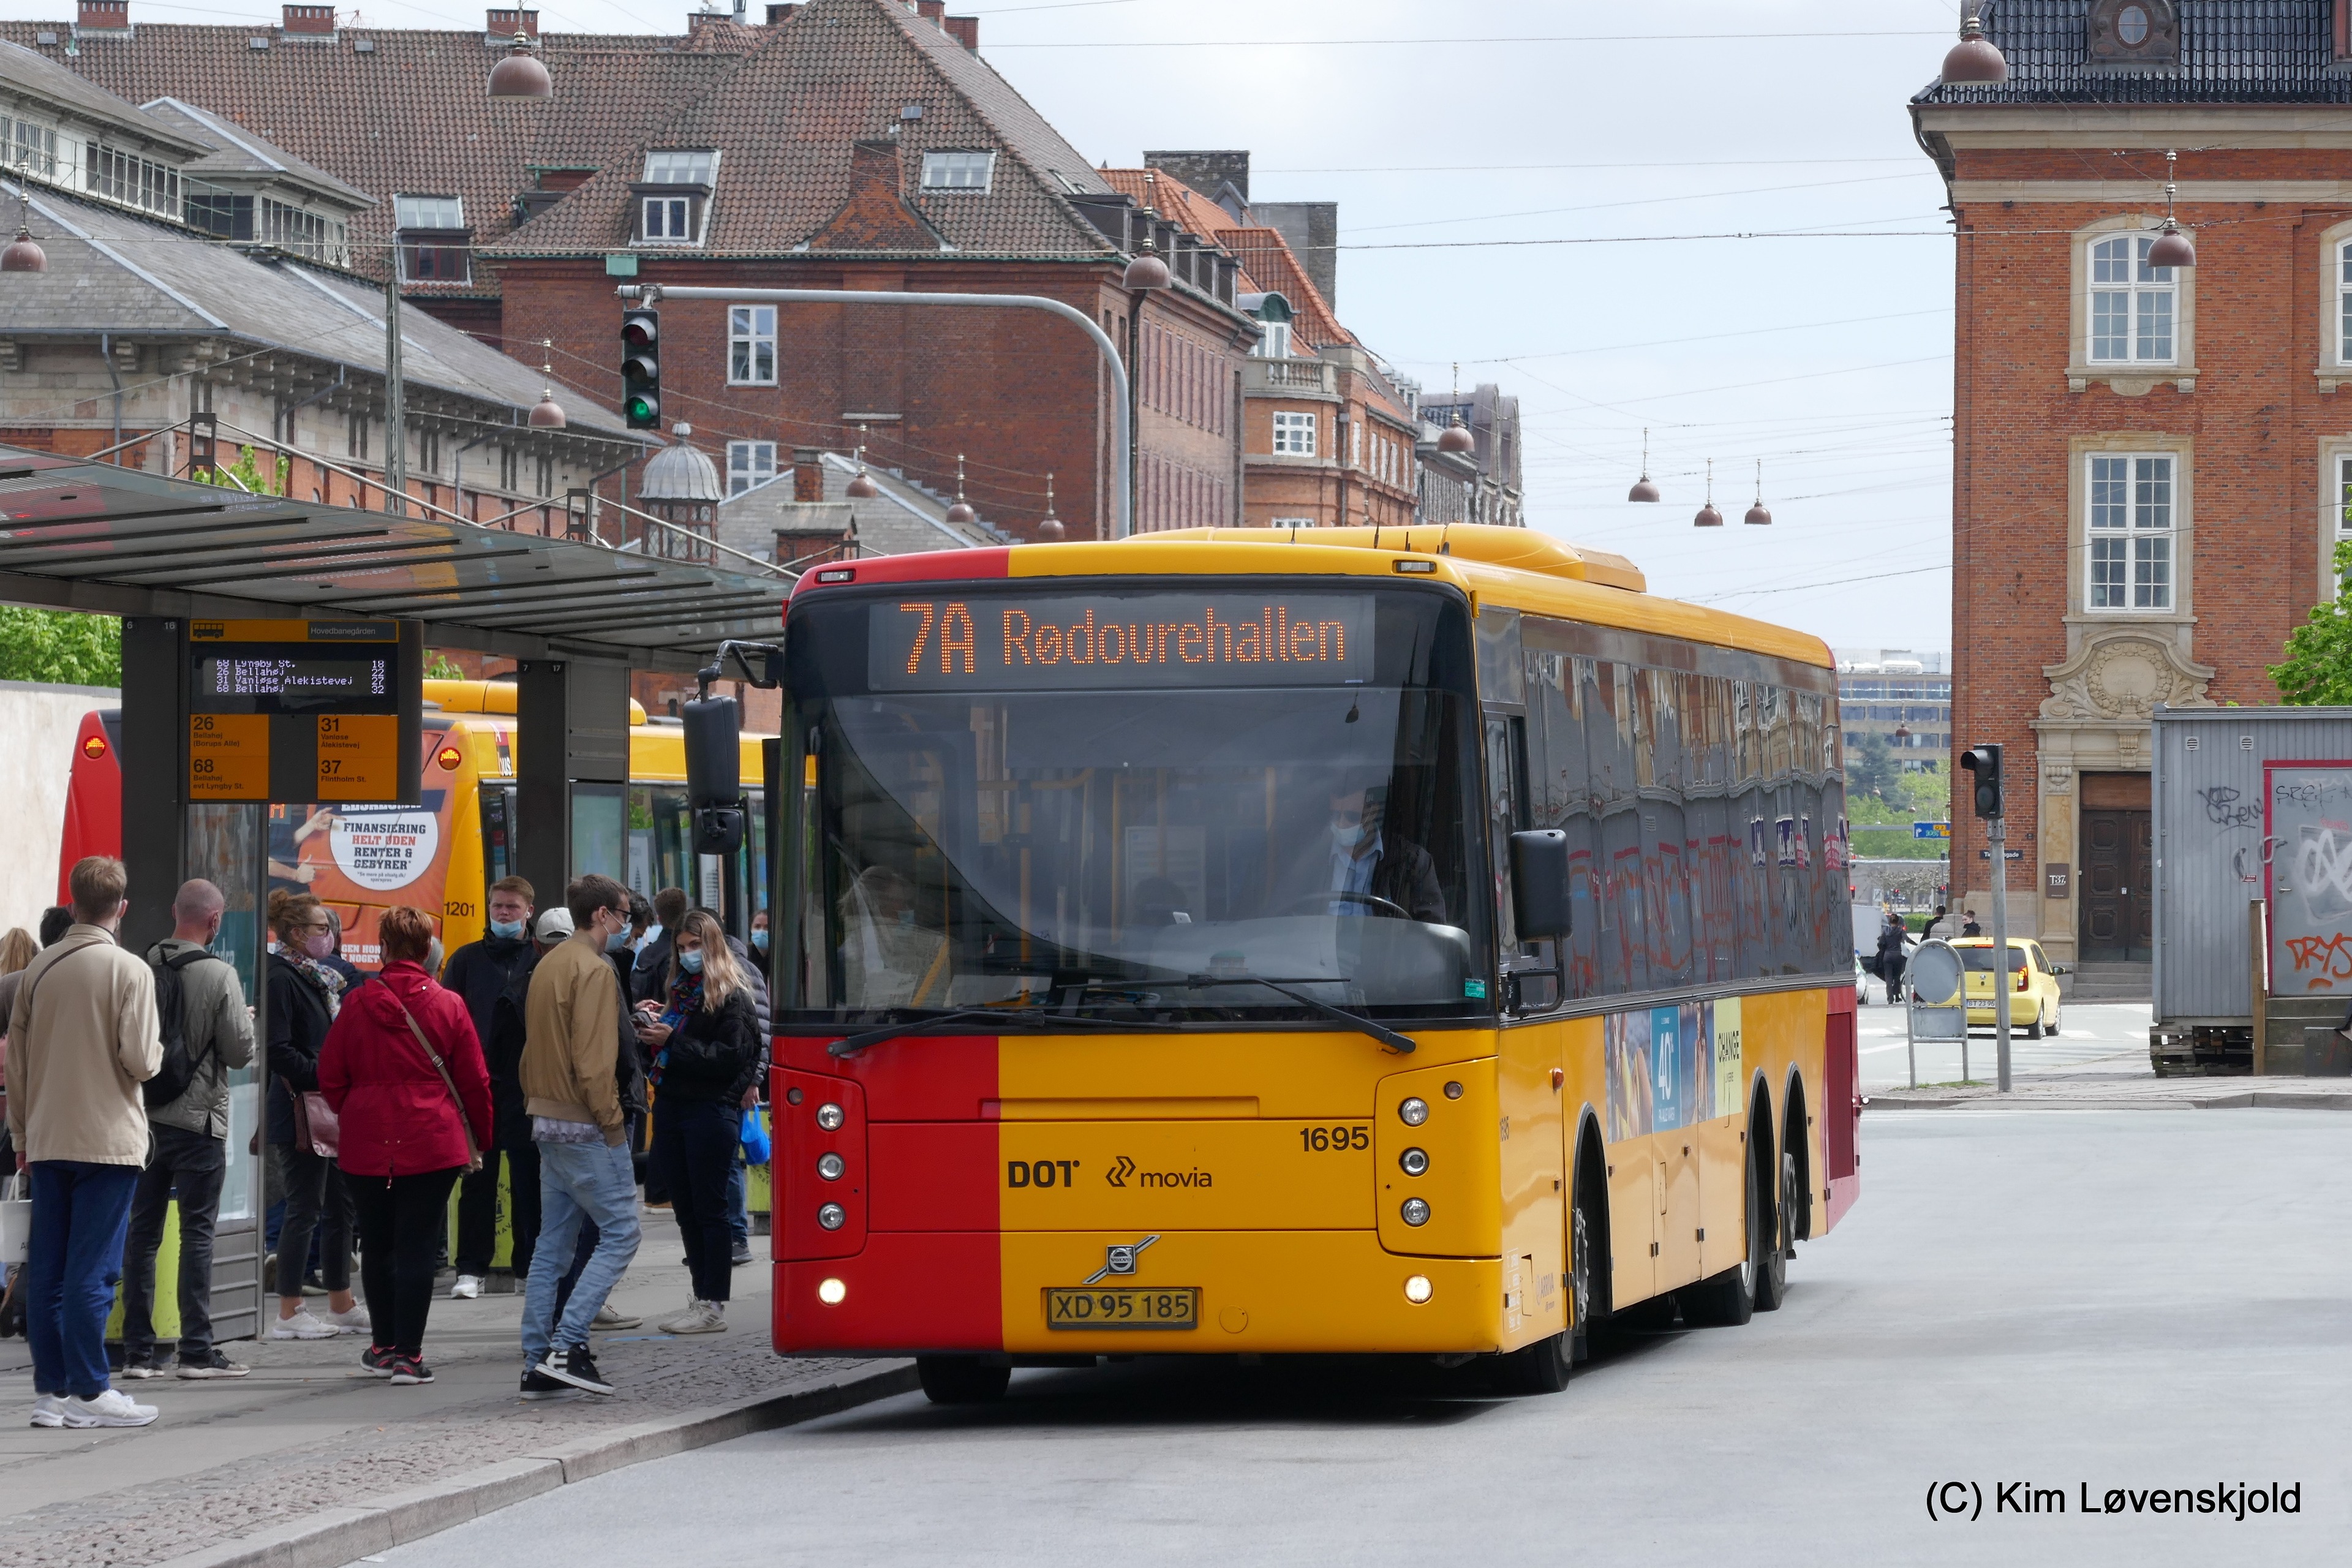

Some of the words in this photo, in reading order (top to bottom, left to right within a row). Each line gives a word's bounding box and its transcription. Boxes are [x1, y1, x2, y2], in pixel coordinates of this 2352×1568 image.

[127, 621, 133, 630] 6
[311, 627, 375, 636] Hovedbanegården
[900, 603, 975, 674] 7A
[1003, 605, 1345, 666] Rødovrehallen
[235, 668, 284, 676] Bellahøj
[235, 685, 284, 693] Bellahøj
[371, 685, 384, 694] 32
[194, 717, 214, 730] 26
[321, 718, 339, 732] 31
[194, 759, 214, 773] 68
[321, 760, 341, 774] 37
[344, 823, 426, 834] FINANSIERING
[352, 835, 382, 845] HELT
[385, 836, 417, 846] UDEN
[354, 847, 401, 858] RENTER
[405, 848, 412, 858] &
[443, 902, 475, 918] 1201
[349, 954, 380, 963] NOGET
[1718, 1030, 1740, 1063] CHANGE
[1300, 1126, 1370, 1153] 1695
[1008, 1159, 1080, 1188] DOT
[1140, 1166, 1213, 1188] movia
[1056, 1295, 1093, 1319] XD
[1099, 1295, 1133, 1319] 95
[1142, 1294, 1189, 1318] 185
